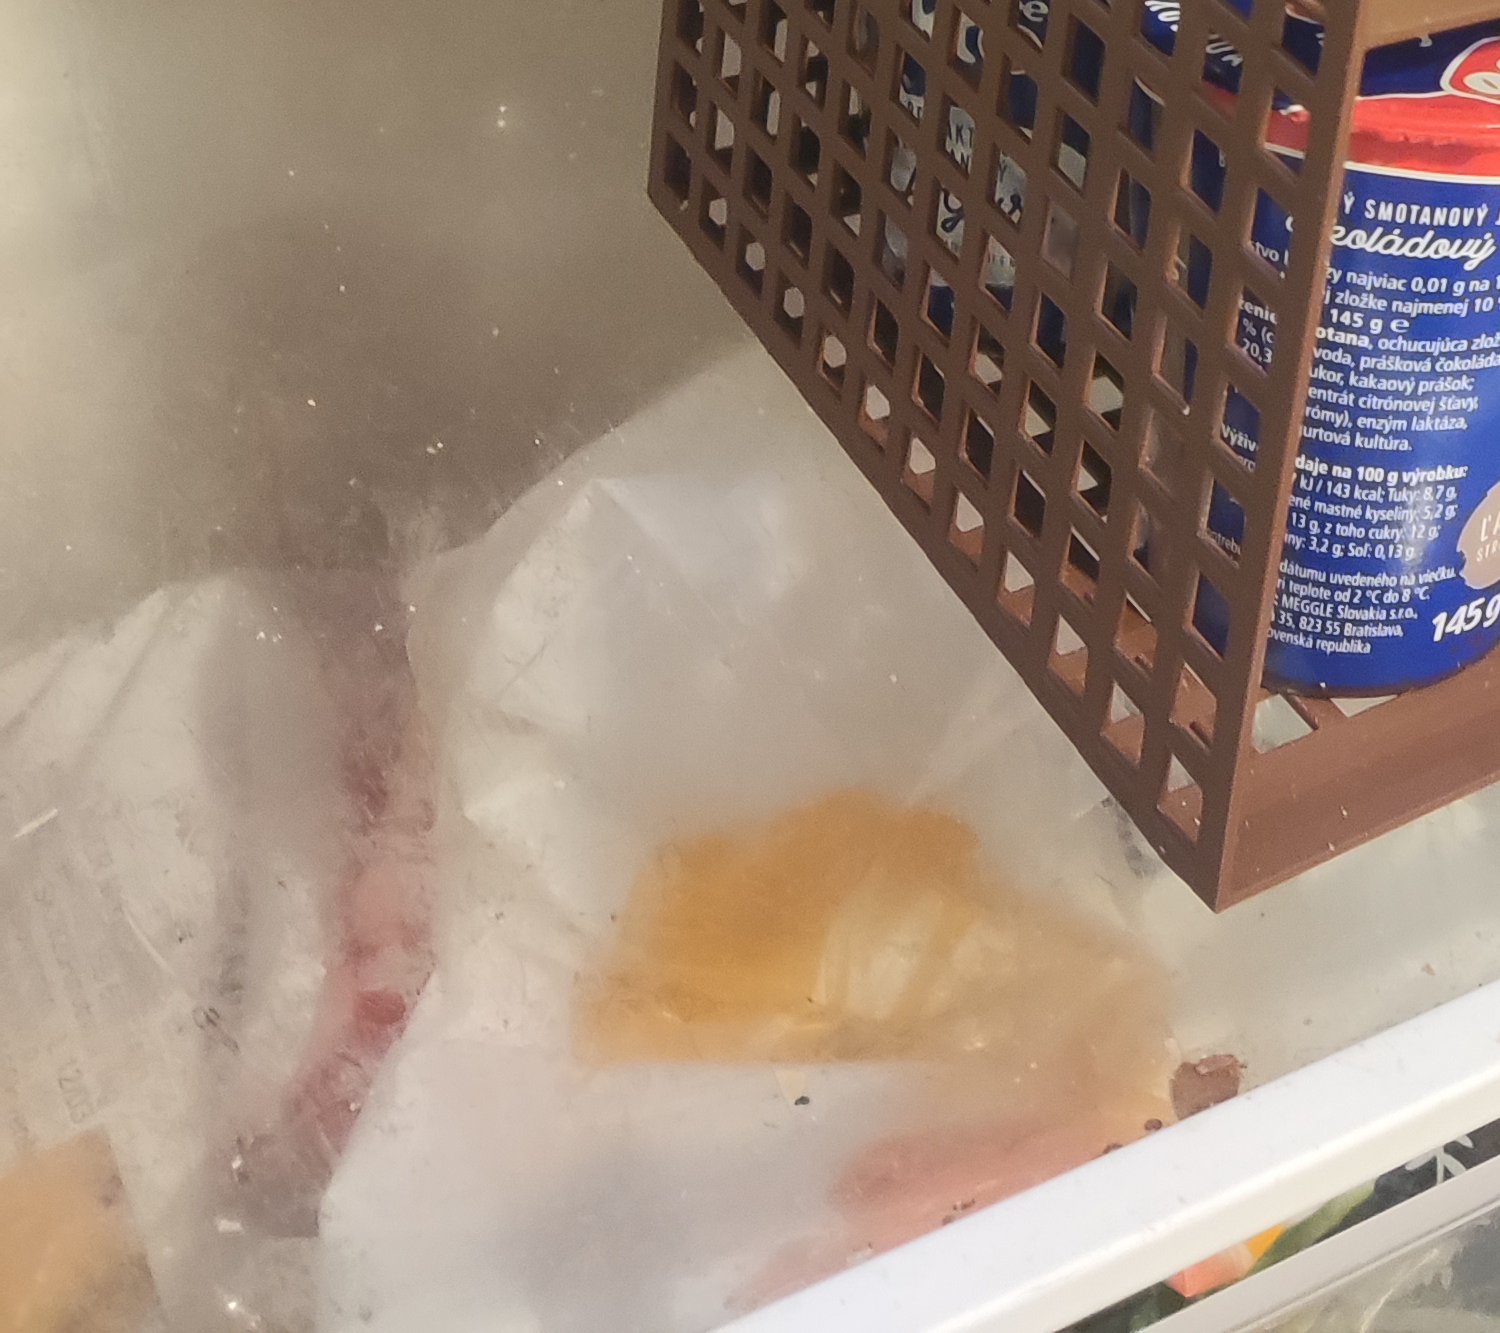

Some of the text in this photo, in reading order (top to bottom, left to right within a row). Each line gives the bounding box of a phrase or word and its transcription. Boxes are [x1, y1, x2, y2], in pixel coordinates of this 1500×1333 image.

[1365, 199, 1489, 227] SMOTANOVÝ
[1346, 270, 1407, 292] najviac
[1411, 277, 1447, 295] 0,01
[1452, 279, 1465, 296] g
[1469, 278, 1490, 293] na
[1335, 289, 1388, 311] zložke
[1392, 298, 1470, 318] najmenej
[1474, 297, 1495, 313] 10
[1330, 308, 1384, 334] 145 g
[1378, 334, 1468, 356] ochucujúca
[1313, 346, 1355, 367] voda,
[1359, 355, 1431, 373] prášková
[1349, 371, 1416, 396] kakaový
[1358, 394, 1436, 415] citrónovej
[1356, 416, 1407, 434] enzým
[1410, 415, 1468, 432] laktáza,
[1354, 433, 1413, 452] kultúra.
[1332, 465, 1352, 480] na
[1356, 467, 1384, 483] 100
[1387, 471, 1399, 486] g
[1402, 465, 1469, 486] výrobku:
[1326, 480, 1351, 498] 143
[1422, 485, 1444, 502] 8,7
[1314, 499, 1363, 520] mastné
[1422, 504, 1443, 522] 5,2
[1335, 523, 1366, 539] toho
[1308, 538, 1328, 554] 3,2
[1374, 545, 1403, 561] 0,13
[1279, 559, 1326, 583] dátumu
[1329, 571, 1397, 588] uvedeného
[1400, 574, 1416, 586] na
[1288, 580, 1332, 602] teplote
[1334, 587, 1351, 602] od
[1383, 588, 1399, 603] do
[1281, 594, 1335, 617] MEGGLE
[1337, 604, 1387, 620] Slovakia
[1299, 617, 1322, 632] 823
[1325, 622, 1341, 635] 55
[1315, 636, 1372, 656] republika
